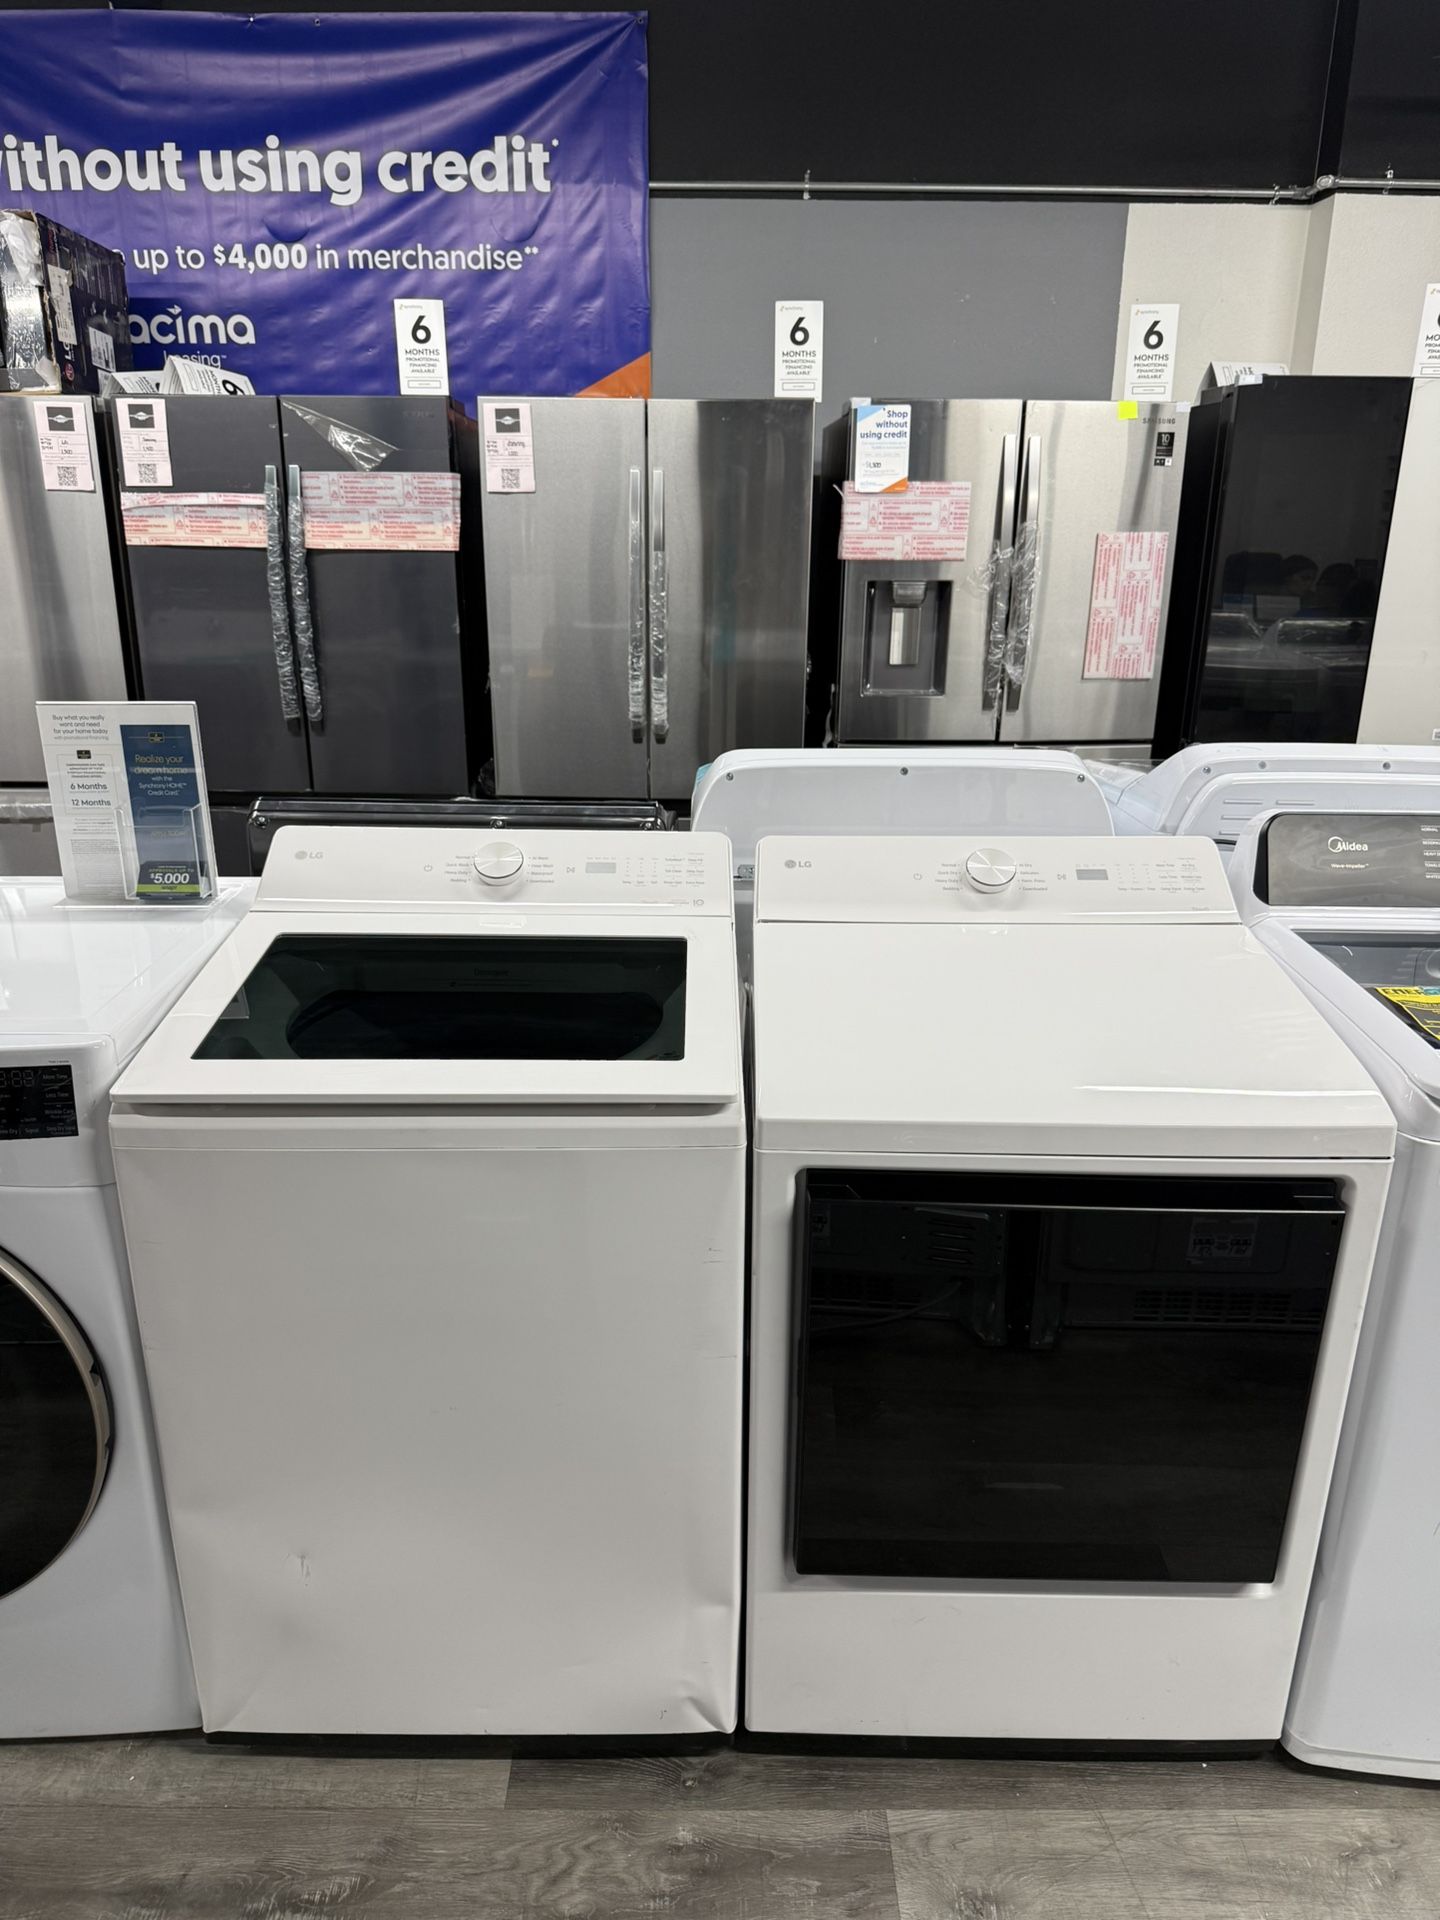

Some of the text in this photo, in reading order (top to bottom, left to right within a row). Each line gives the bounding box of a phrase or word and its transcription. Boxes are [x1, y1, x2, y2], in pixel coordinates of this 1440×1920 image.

[0, 134, 187, 193] ithout
[200, 134, 364, 206] using
[133, 248, 169, 275] up
[175, 245, 205, 270] to
[213, 243, 307, 274] $4,000
[316, 244, 340, 270] in
[129, 304, 256, 345] acima
[411, 315, 432, 344] 6
[790, 316, 810, 346] 6
[1143, 319, 1164, 350] 6
[405, 348, 440, 356] MONTHS
[782, 350, 817, 358] MONTHS
[1134, 354, 1169, 362] MONTHS
[887, 409, 909, 420] Shop
[876, 420, 908, 429] without
[860, 430, 908, 440] using credit
[87, 714, 105, 722] really
[62, 728, 74, 736] your
[91, 727, 108, 735] today
[135, 754, 184, 765] Realize your
[70, 782, 107, 791] 6 Months
[71, 798, 111, 807] 12 Months
[1327, 836, 1369, 853] Midea
[308, 851, 323, 859] LG
[798, 860, 812, 868] LG
